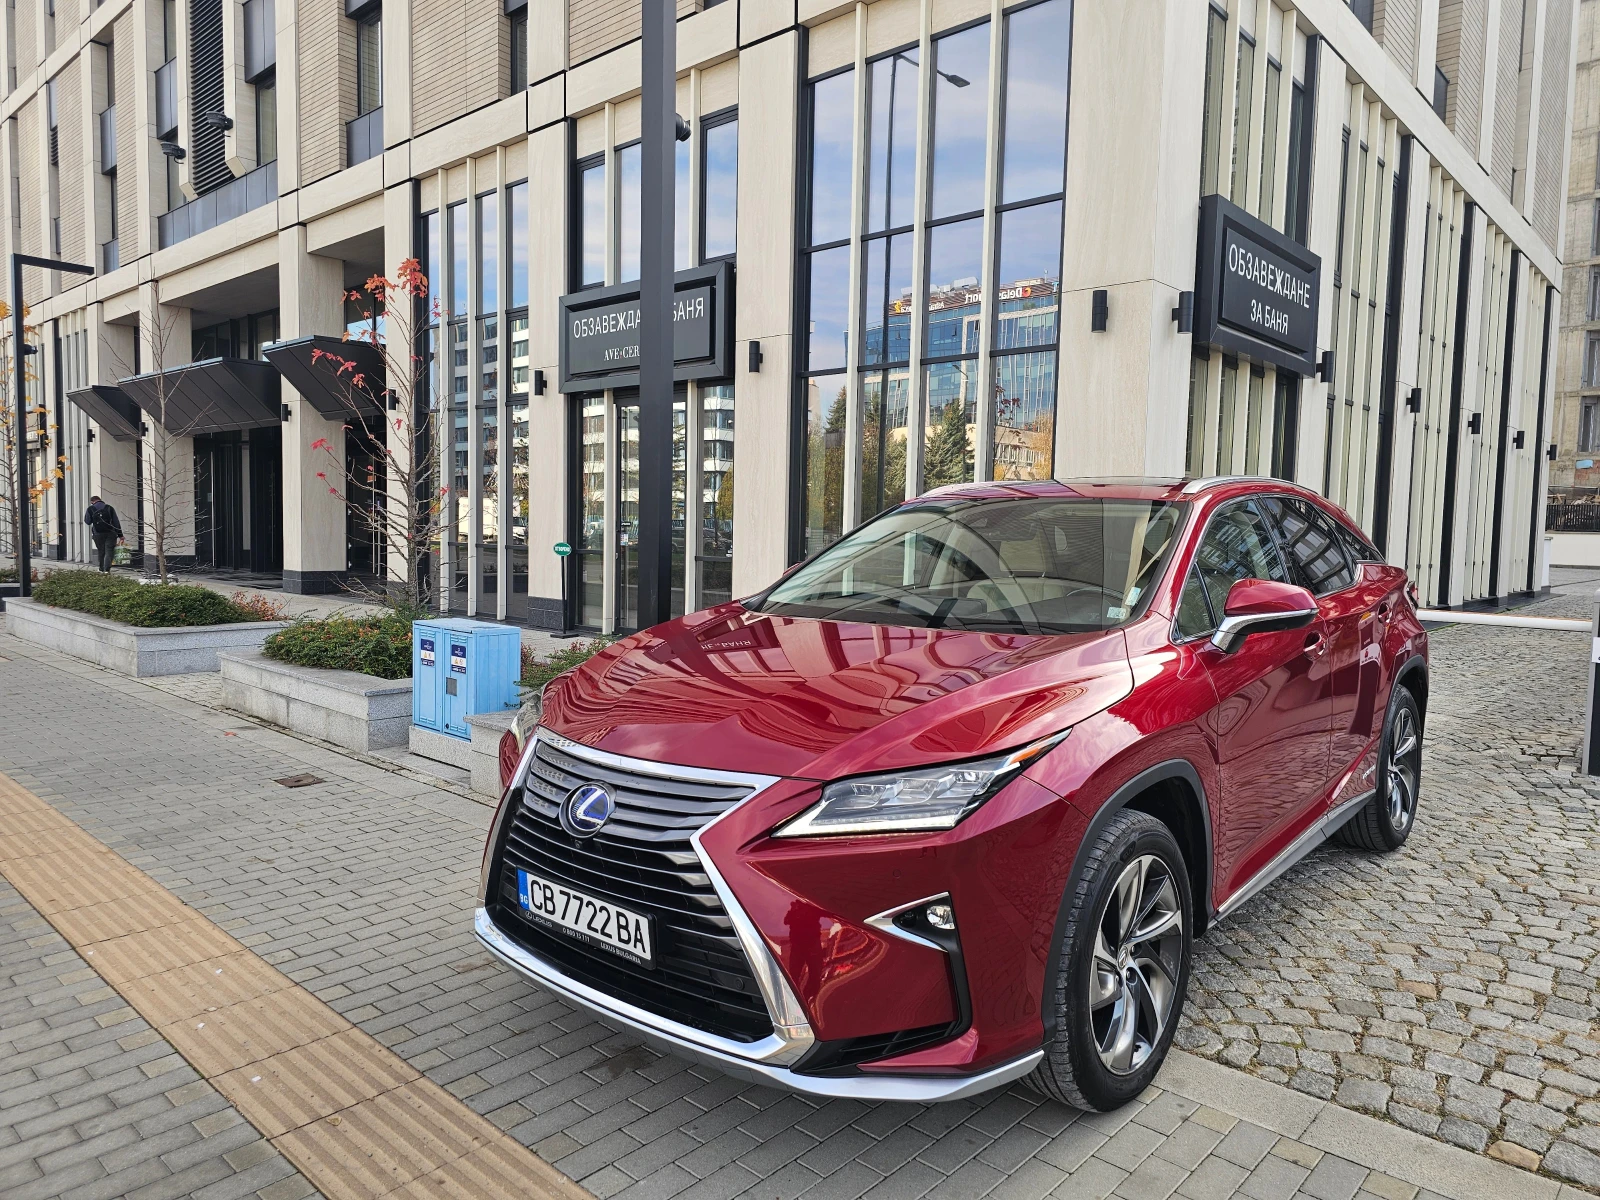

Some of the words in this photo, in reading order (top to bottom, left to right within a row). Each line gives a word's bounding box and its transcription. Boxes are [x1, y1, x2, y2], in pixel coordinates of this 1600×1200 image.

[1228, 244, 1311, 309] ОБЗАВЕЖДАНЕ
[573, 308, 641, 339] ОБЗАВЕЖДА
[1250, 299, 1263, 325] ЗА
[1264, 306, 1289, 335] БАНЯ
[519, 893, 529, 904] BG
[530, 880, 556, 916] CB
[559, 890, 613, 940] 7722
[616, 910, 647, 953] BA
[600, 942, 616, 953] LEXUS
[615, 948, 642, 965] BULGARIA
